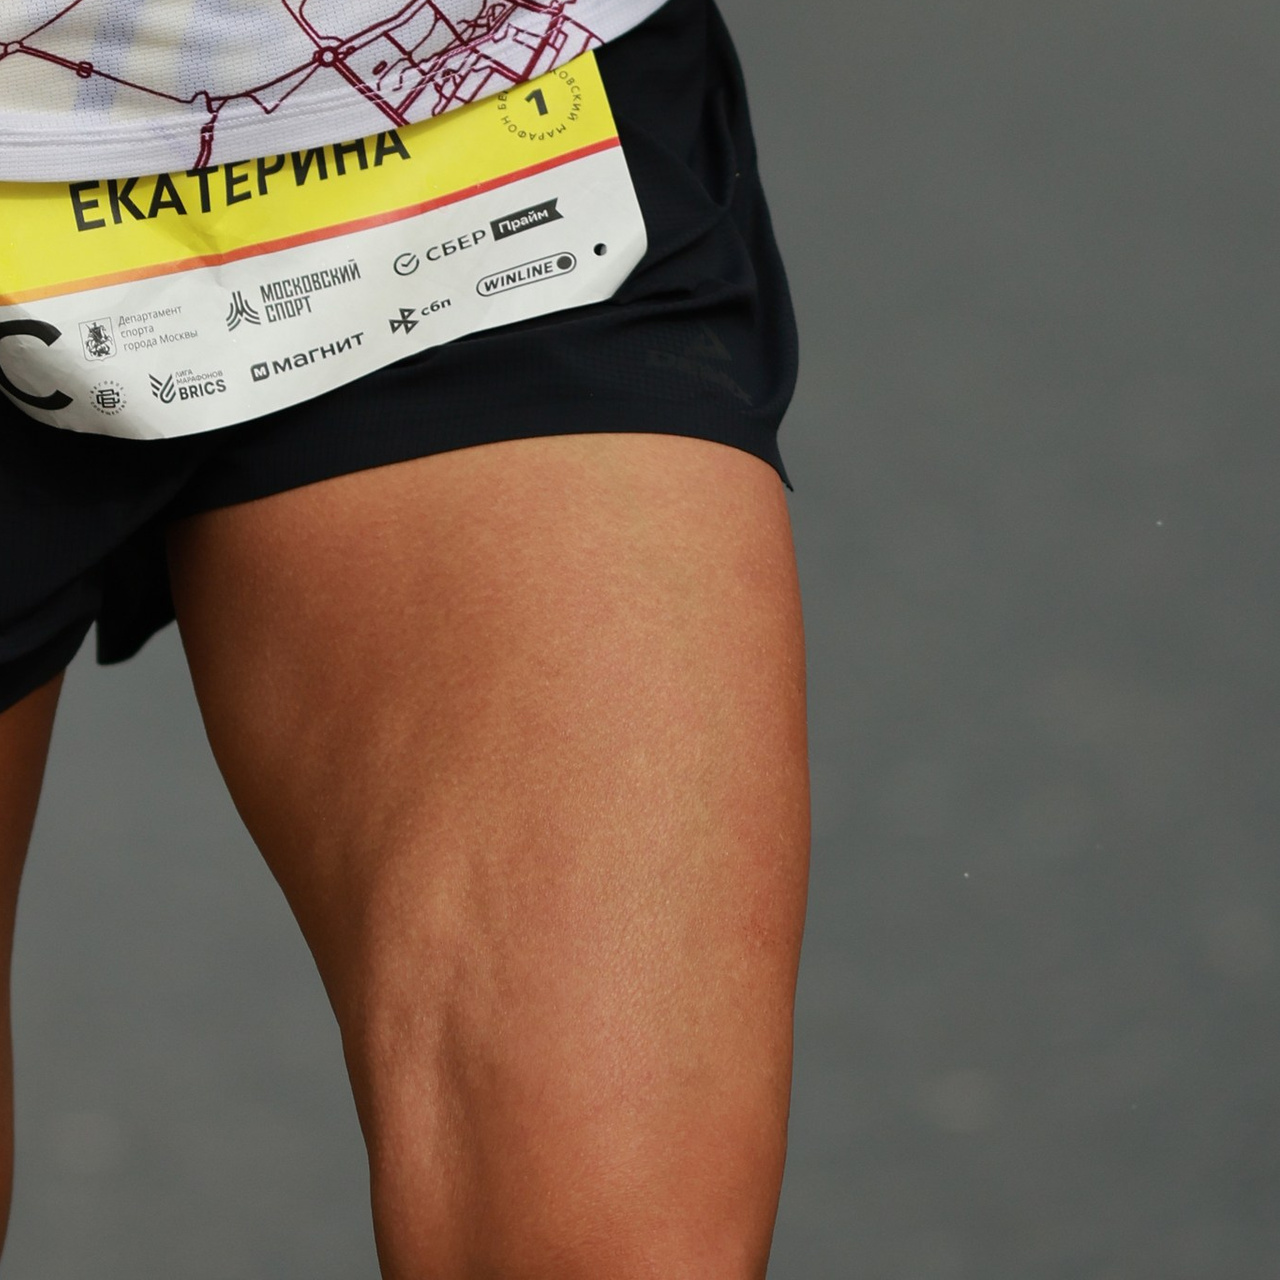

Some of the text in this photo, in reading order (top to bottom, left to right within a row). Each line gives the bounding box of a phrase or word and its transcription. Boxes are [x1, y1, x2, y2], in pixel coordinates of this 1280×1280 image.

[524, 88, 549, 116] 1
[501, 115, 567, 140] МАРАФОН
[68, 129, 411, 232] ЕКАТЕРИНА
[426, 207, 550, 262] СБЕР Прайм
[260, 259, 361, 303] МОСКОВСКИЙ
[483, 261, 554, 293] WINLINE
[118, 306, 182, 327] Департамент
[264, 295, 312, 323] СПОРТ
[421, 298, 452, 317] сбп
[120, 325, 155, 339] спорта
[123, 330, 198, 351] города Москвы
[175, 368, 193, 378] ЛИГА
[175, 370, 223, 386] МАРАФОНОВ
[178, 379, 227, 400] BRICS
